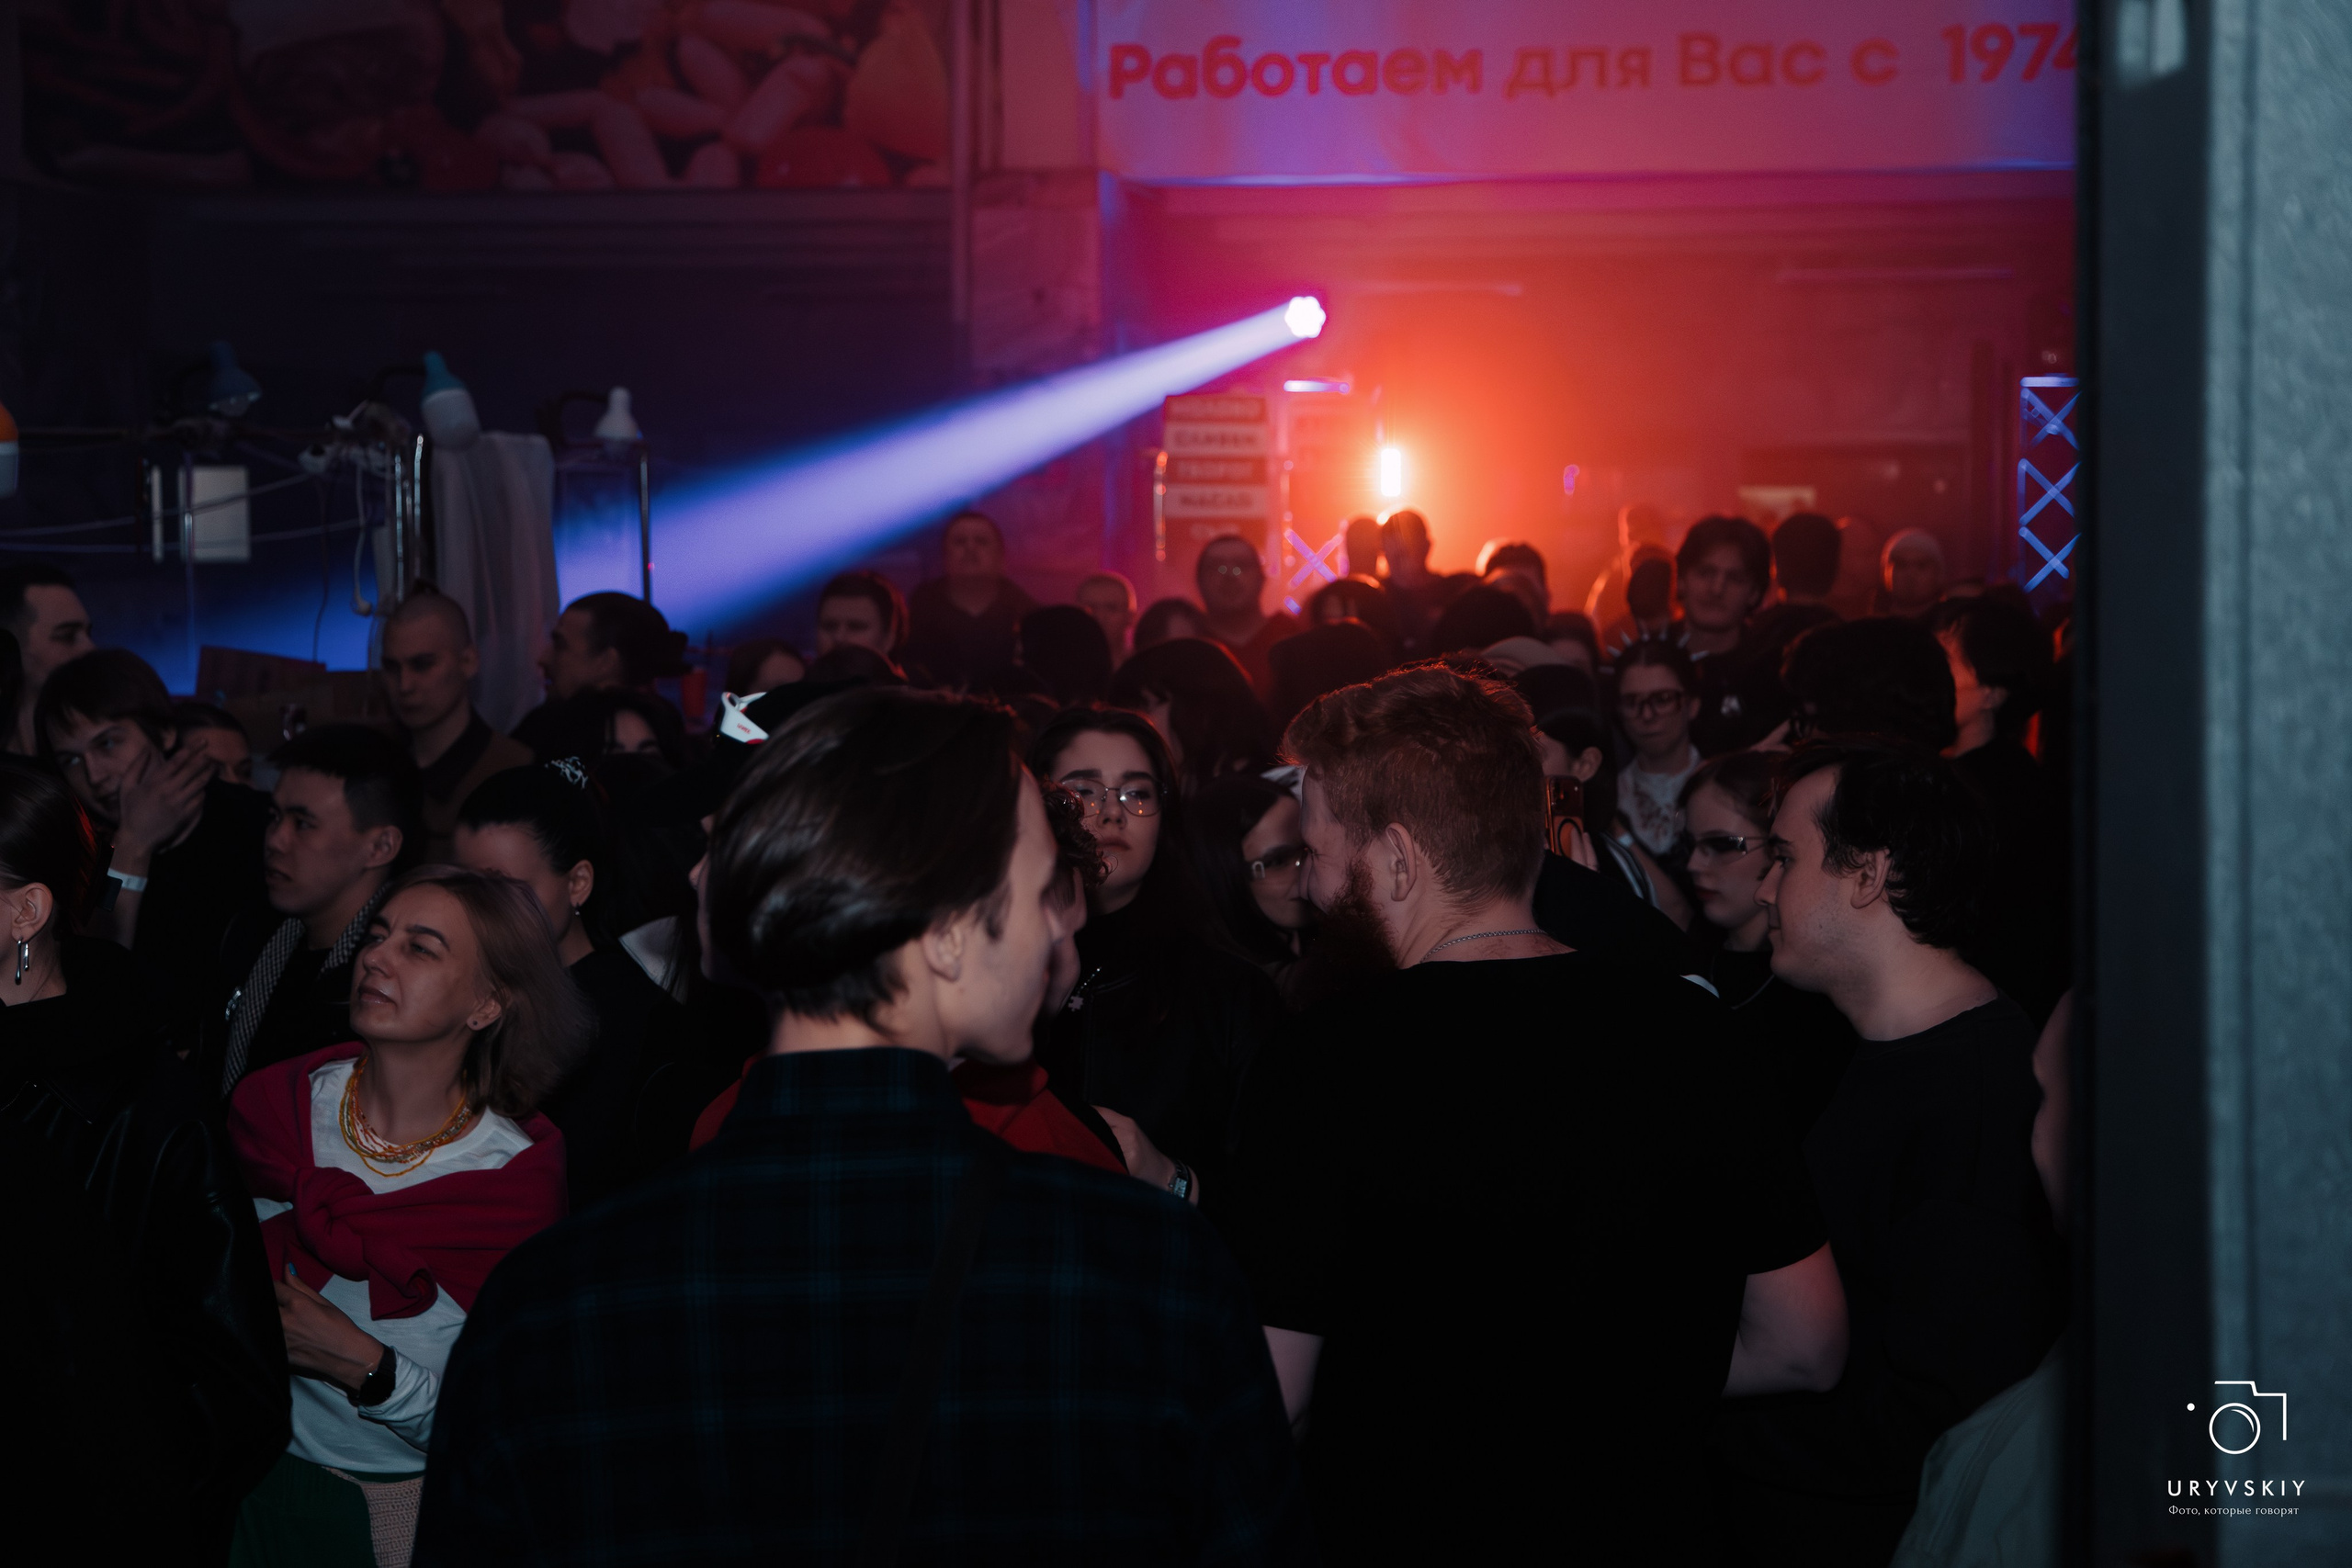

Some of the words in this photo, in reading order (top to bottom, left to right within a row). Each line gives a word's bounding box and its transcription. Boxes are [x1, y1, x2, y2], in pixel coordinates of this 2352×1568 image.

[1109, 36, 1483, 99] Работаем
[1507, 47, 1652, 99] для
[1679, 33, 1826, 86] Вас
[1850, 39, 1899, 85] с
